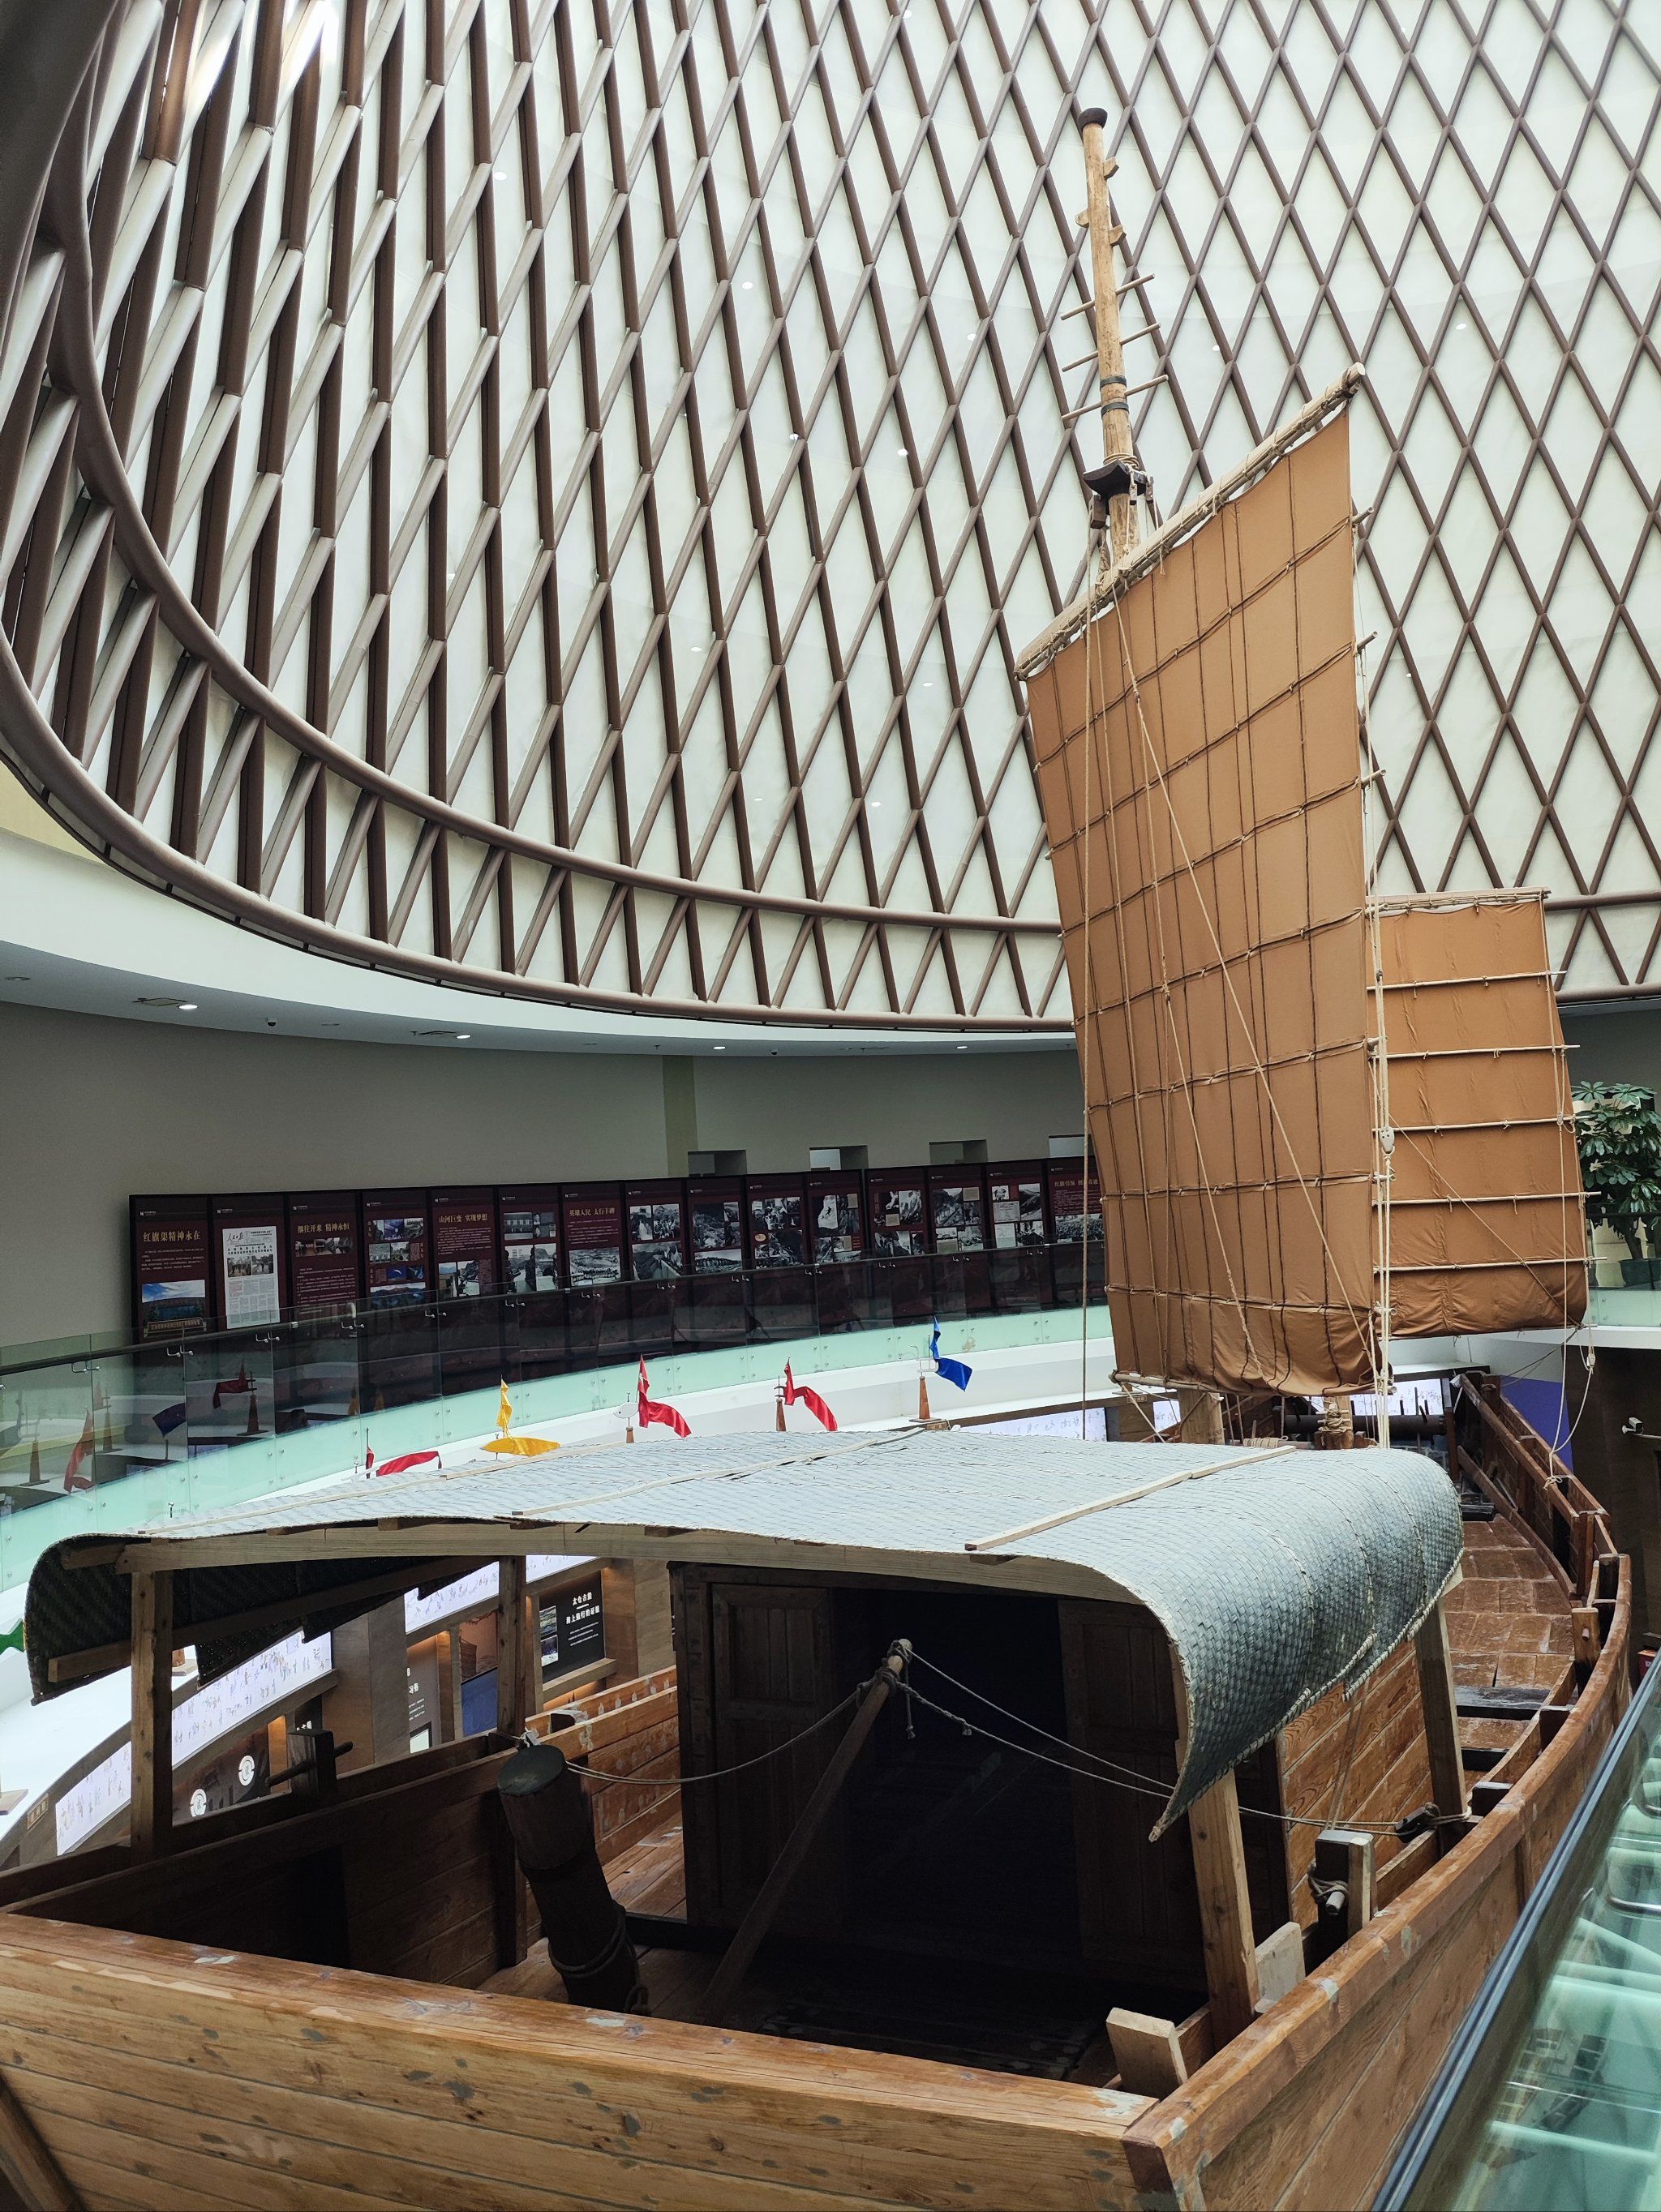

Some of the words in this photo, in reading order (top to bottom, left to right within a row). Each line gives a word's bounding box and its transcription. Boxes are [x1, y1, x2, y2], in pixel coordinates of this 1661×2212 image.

[143, 1230, 201, 1242] 红旗渠精神永在
